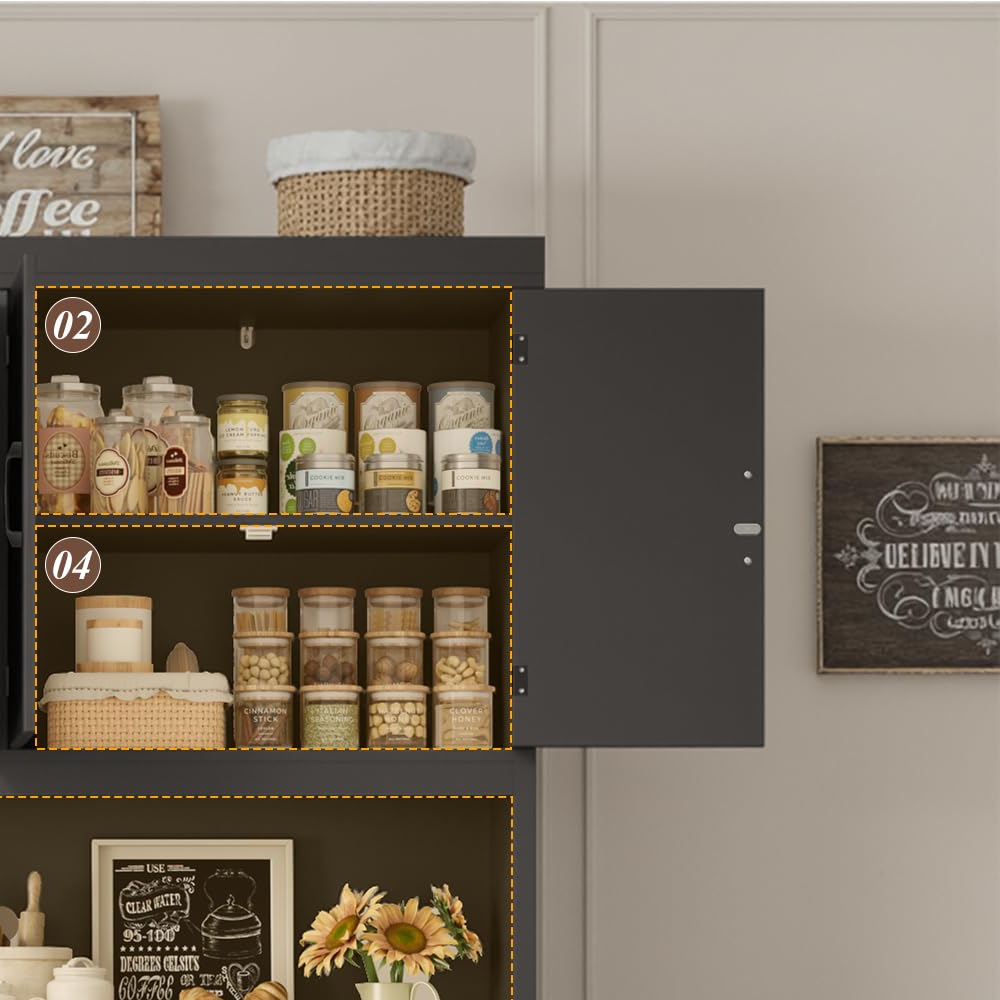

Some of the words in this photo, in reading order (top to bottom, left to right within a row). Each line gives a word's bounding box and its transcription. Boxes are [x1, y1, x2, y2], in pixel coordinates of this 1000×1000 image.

[11, 127, 97, 170] love
[253, 715, 279, 723] STICK
[146, 863, 166, 874] USE
[125, 899, 153, 914] CLEAR
[153, 892, 182, 909] WATER
[122, 928, 176, 942] 95-100
[120, 955, 161, 973] DEGREES
[163, 955, 200, 973] CELSIUS
